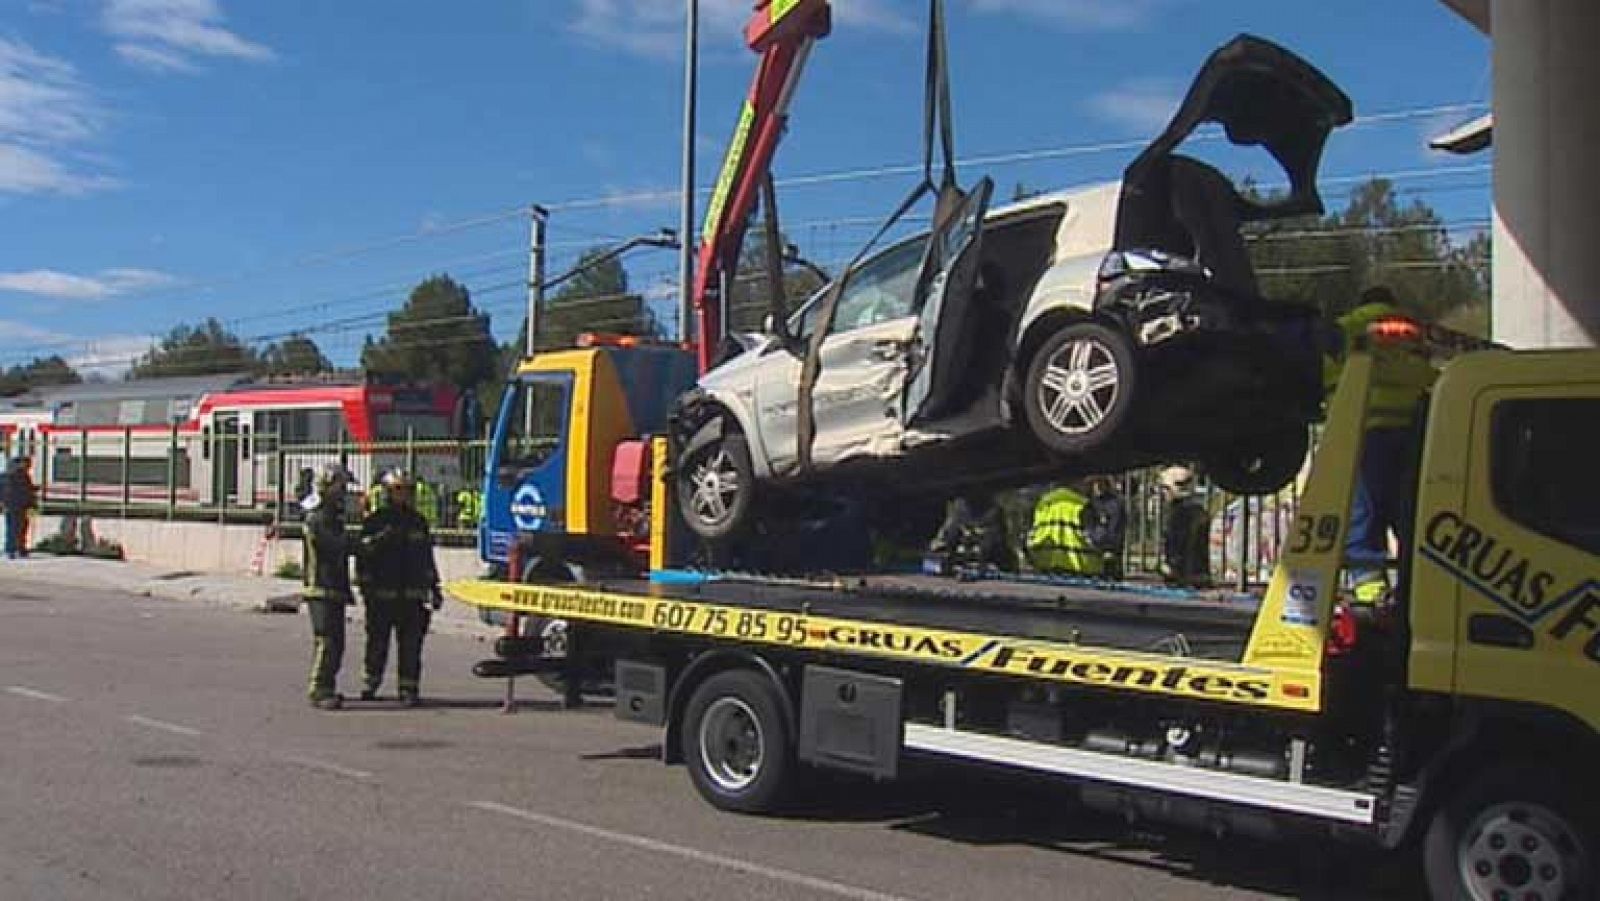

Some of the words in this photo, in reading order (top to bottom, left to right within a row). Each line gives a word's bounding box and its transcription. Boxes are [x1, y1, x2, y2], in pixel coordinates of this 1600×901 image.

[1290, 514, 1340, 553] 39
[1425, 511, 1554, 608] GRUAS
[653, 602, 696, 627] 607
[702, 610, 728, 634] 75
[737, 612, 767, 637] 85
[777, 616, 807, 644] 95
[828, 625, 963, 657] GRUAS
[993, 645, 1269, 700] Fuentes
